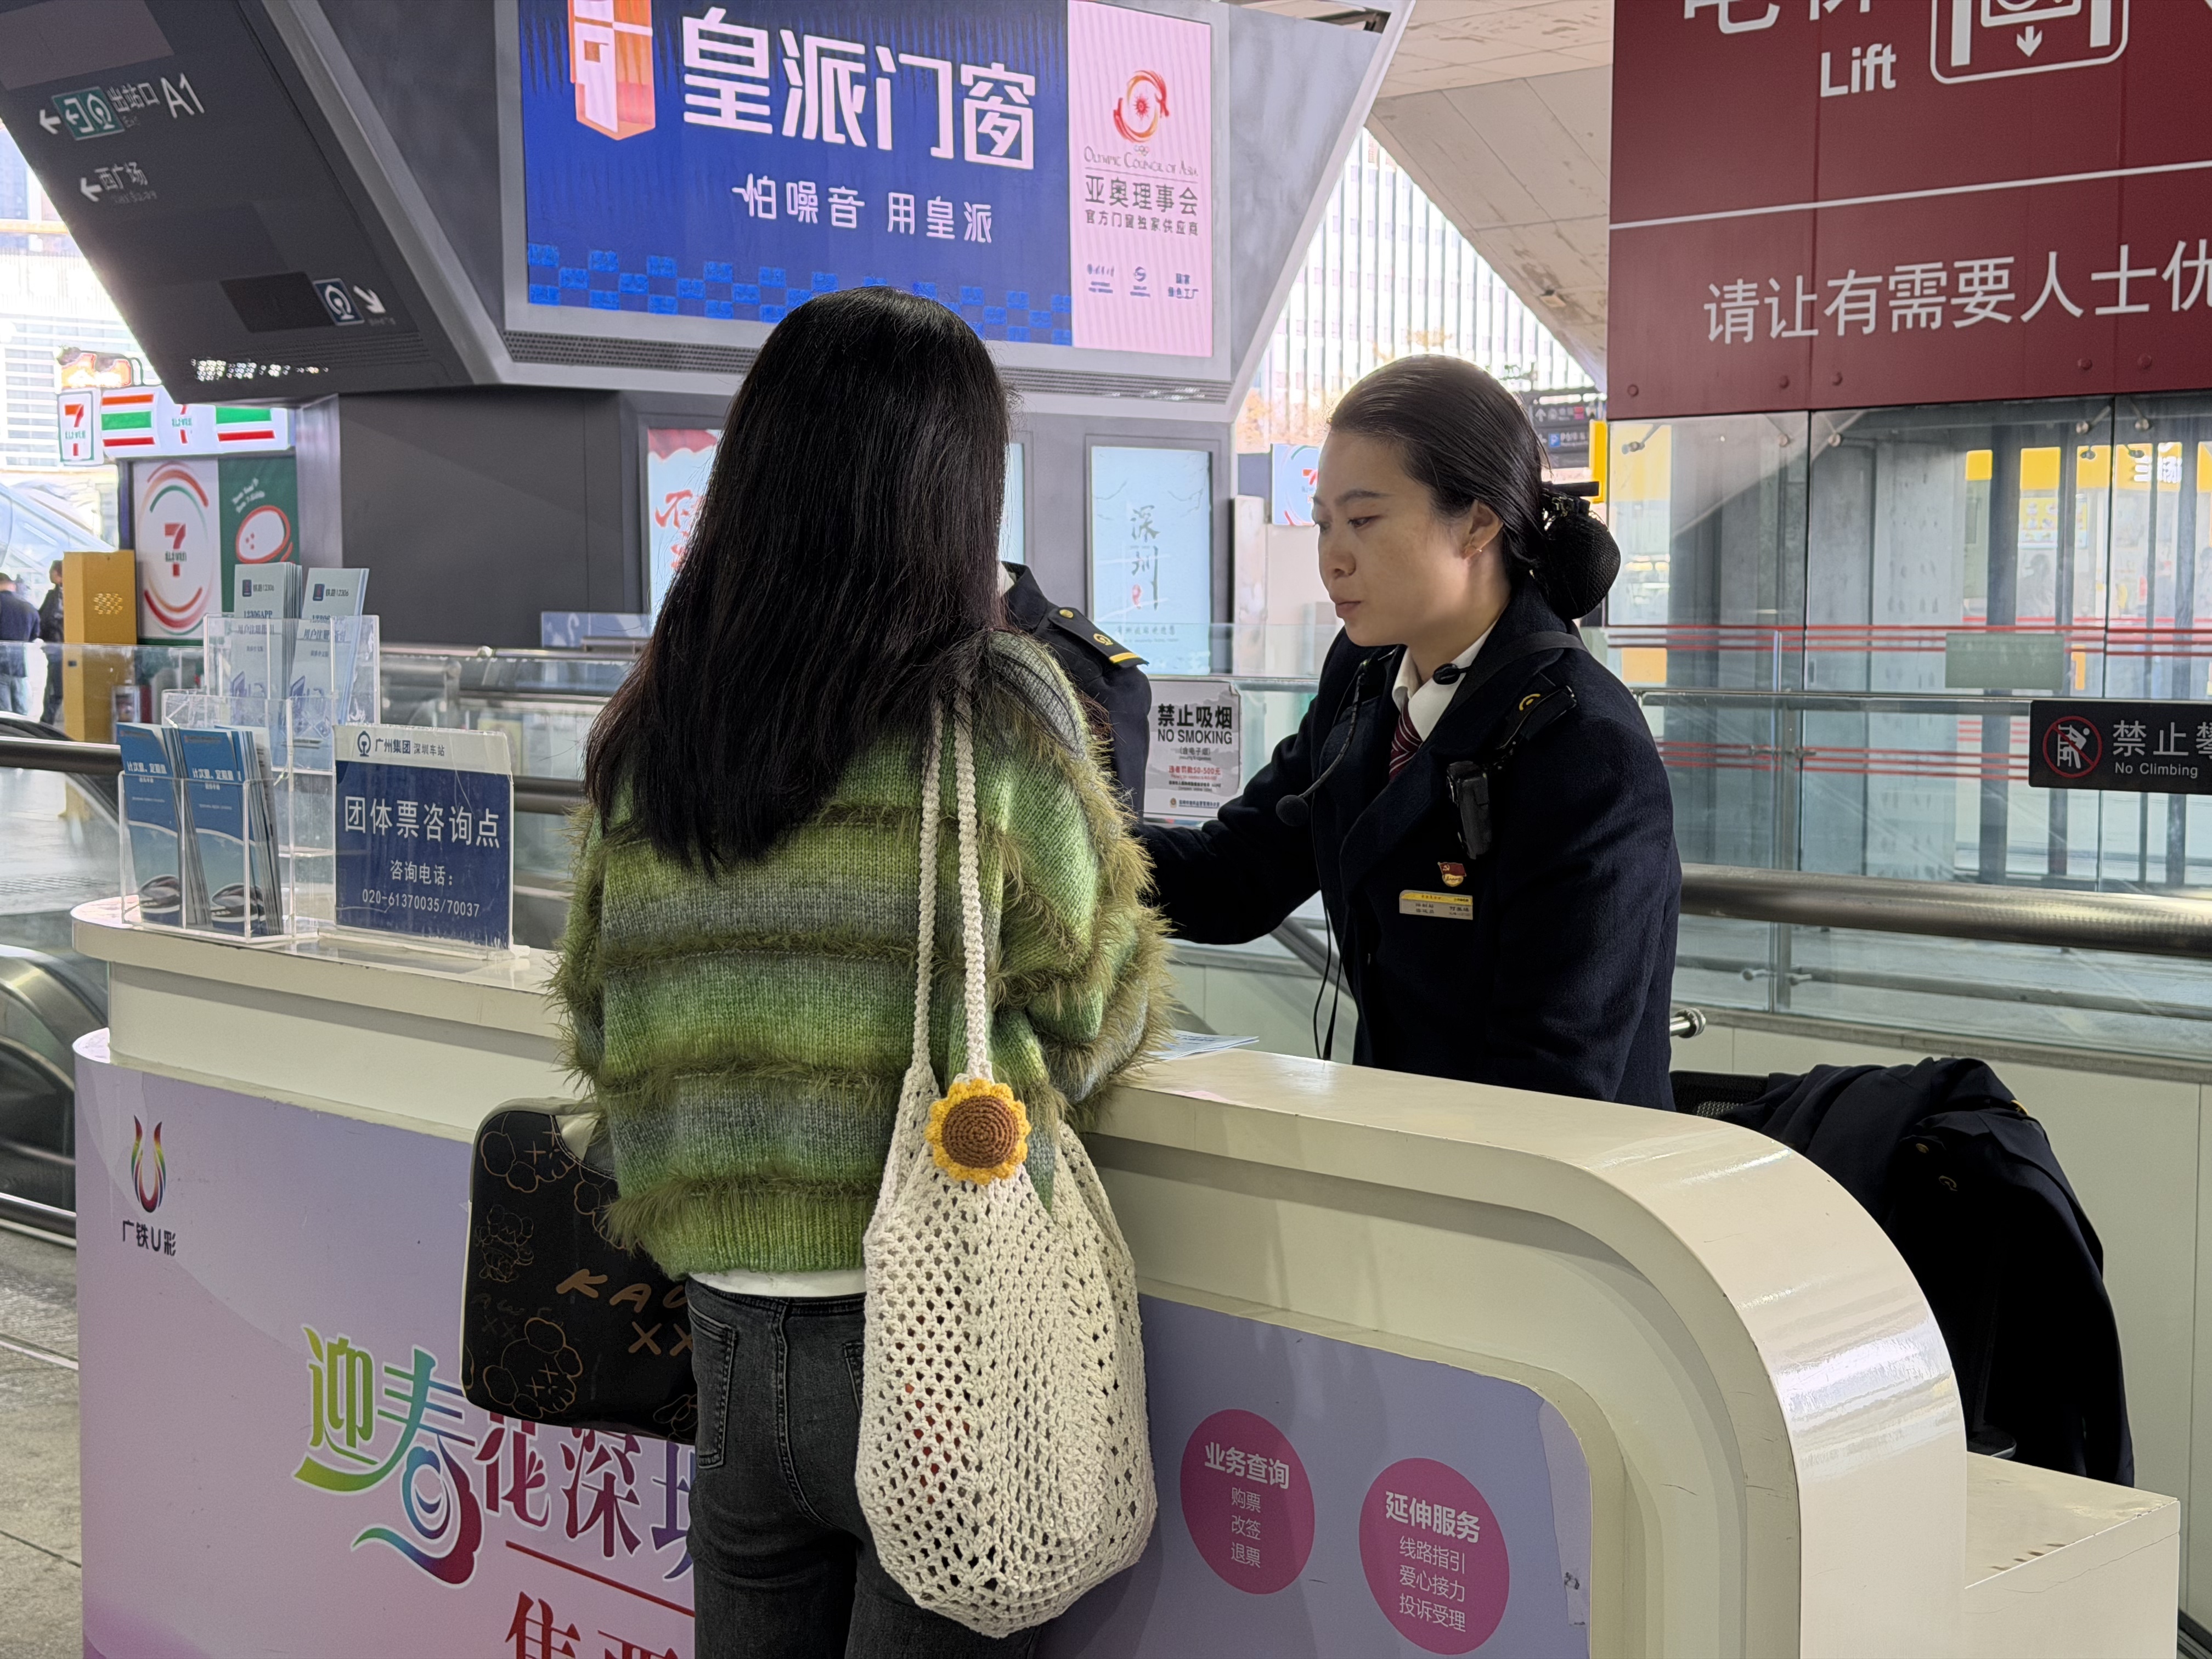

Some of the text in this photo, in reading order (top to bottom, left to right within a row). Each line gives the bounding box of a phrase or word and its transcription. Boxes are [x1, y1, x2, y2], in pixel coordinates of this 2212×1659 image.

[682, 6, 1035, 170] 皇派门窗
[1820, 43, 1897, 98] Lift
[108, 72, 205, 119] 出站口 A1
[94, 162, 148, 190] 西广场
[731, 173, 992, 243] 怕噪音 用皇派
[1085, 174, 1199, 216] 亚奥理事会
[1703, 239, 2212, 345] 请让有需要人士优
[1158, 703, 1232, 729] 禁止吸烟
[375, 738, 445, 757] 广州集团 深圳车站
[1158, 729, 1232, 744] NO SMOKING
[2115, 762, 2198, 778] No Climbing
[345, 795, 500, 849] 团体票咨询点
[390, 859, 453, 886] 咨询电话：
[362, 889, 480, 917] 020-61370035/70037
[122, 1220, 176, 1256] 广铁U彩
[1205, 1442, 1289, 1489] 业务查询
[1231, 1487, 1261, 1513] 购票
[1386, 1491, 1480, 1543] 延伸服务
[1232, 1515, 1261, 1541] 改签
[1231, 1542, 1261, 1568] 退票
[1400, 1536, 1465, 1575] 线路指引
[1400, 1565, 1465, 1602] 爱心接力
[1400, 1593, 1466, 1633] 投诉受理
